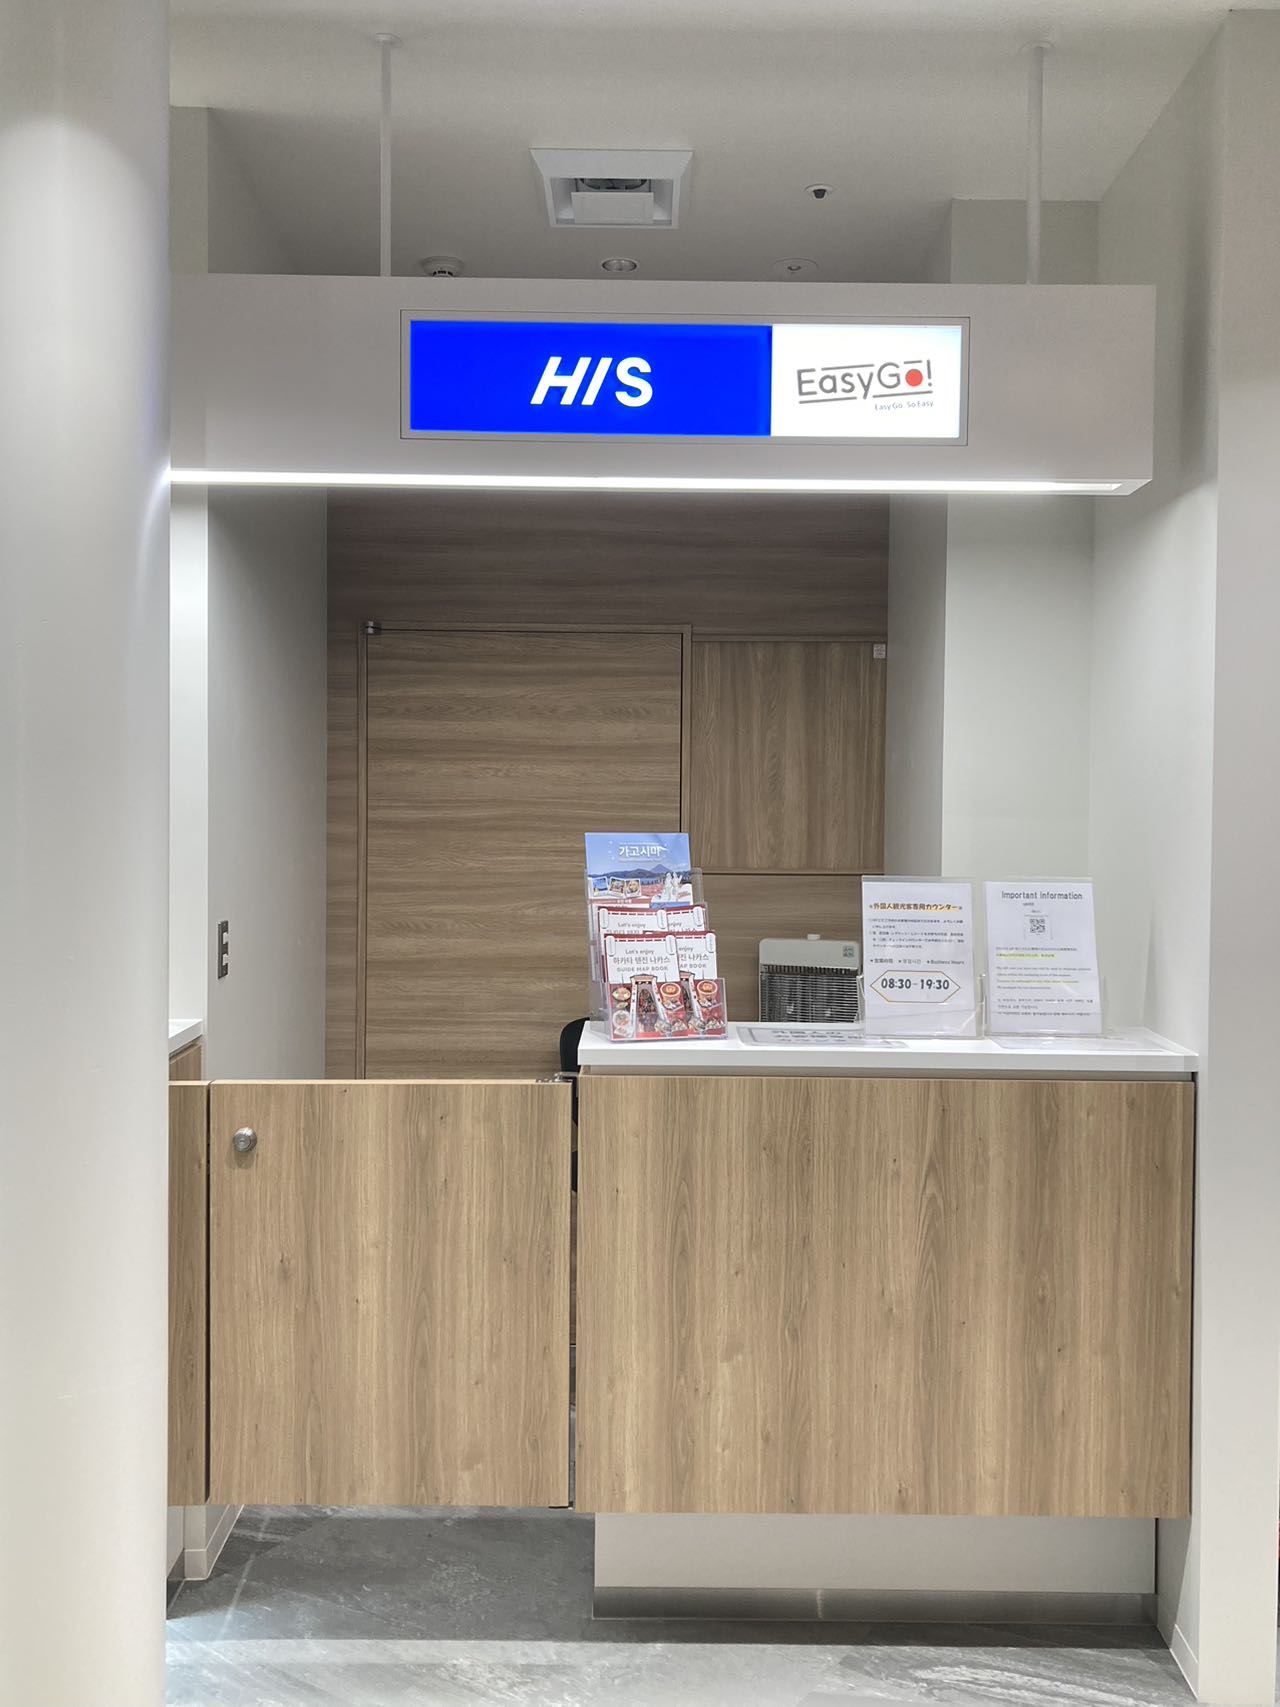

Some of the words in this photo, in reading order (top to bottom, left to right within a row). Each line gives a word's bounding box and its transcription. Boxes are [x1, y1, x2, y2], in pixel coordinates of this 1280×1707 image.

[530, 356, 653, 408] HIS
[619, 845, 663, 858] 가고시마
[1001, 890, 1038, 900] Important
[1039, 891, 1083, 900] Information
[640, 949, 655, 957] enjoy
[688, 952, 709, 961] 나카스
[613, 956, 633, 965] 하카타
[649, 955, 671, 964] 나카스
[881, 978, 912, 989] 08:30
[920, 979, 950, 990] 19:30
